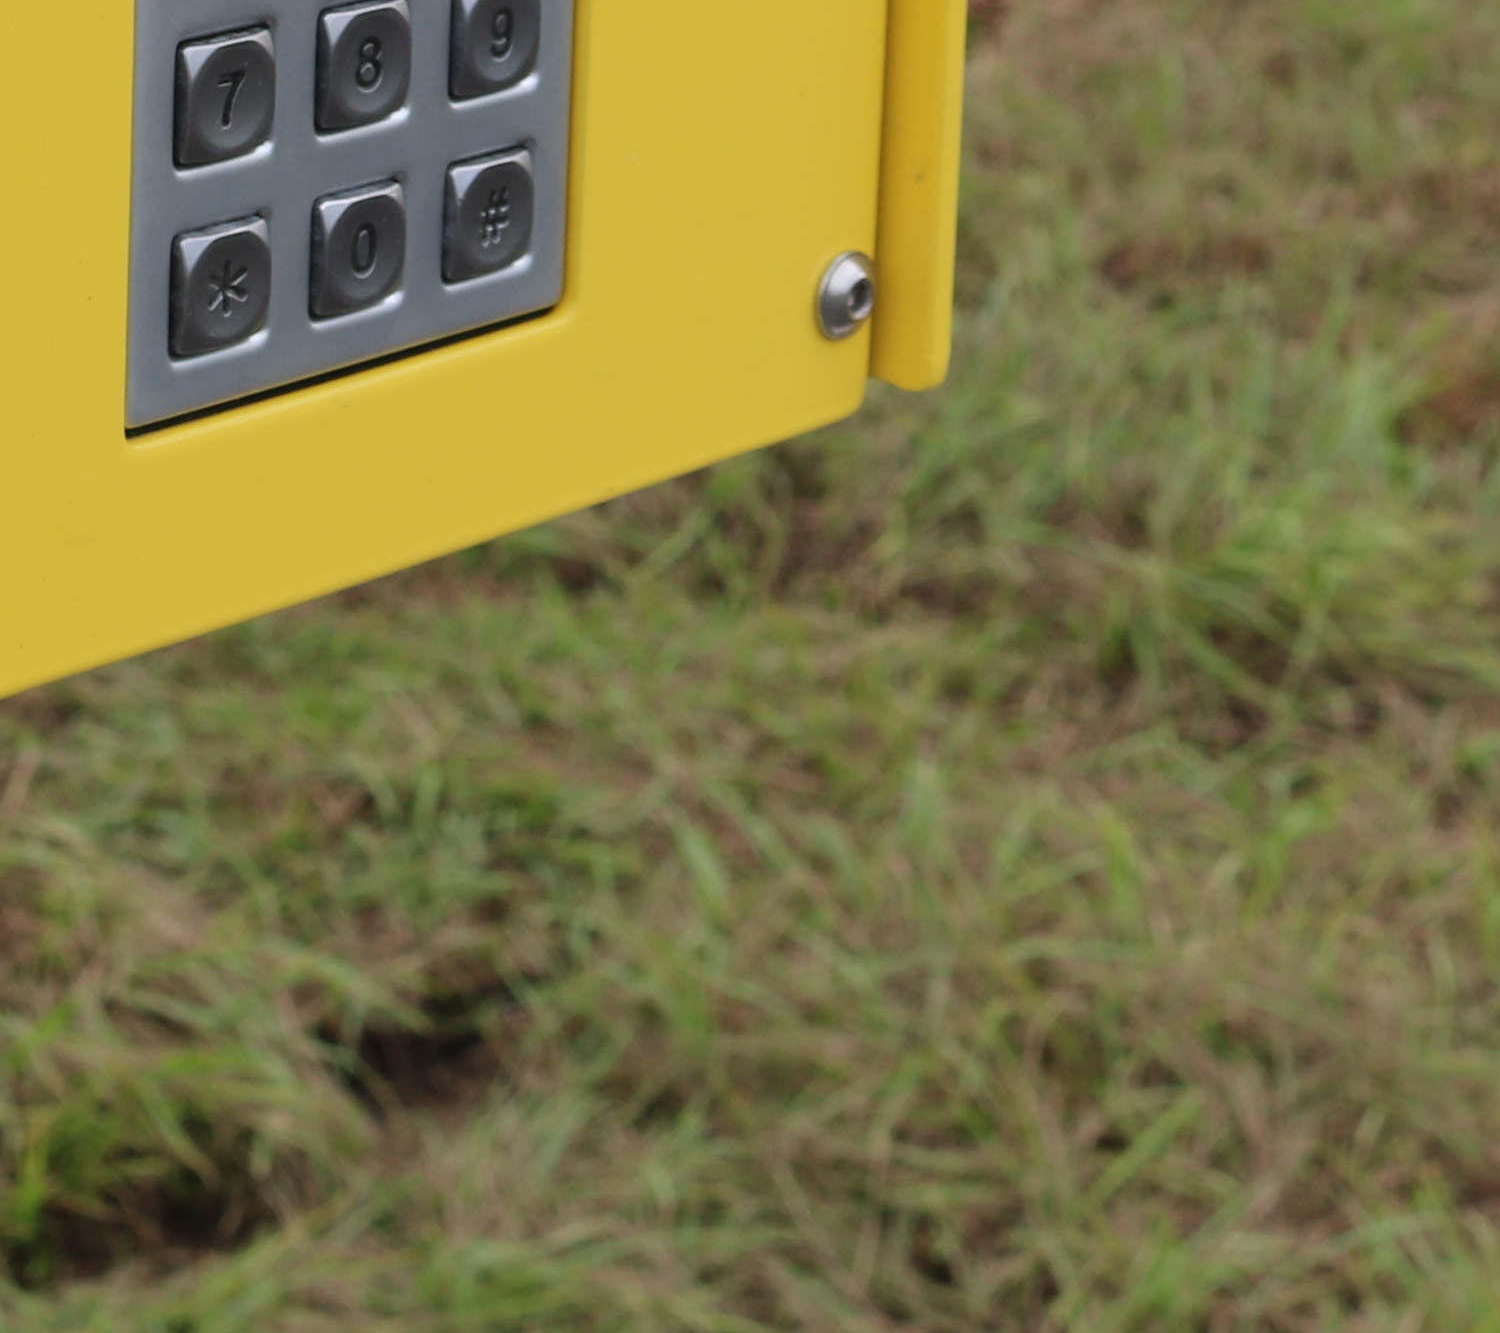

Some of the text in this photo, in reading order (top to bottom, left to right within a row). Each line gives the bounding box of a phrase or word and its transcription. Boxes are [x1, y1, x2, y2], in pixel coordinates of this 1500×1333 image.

[217, 12, 515, 131] 7 8 9
[350, 221, 377, 279] 0
